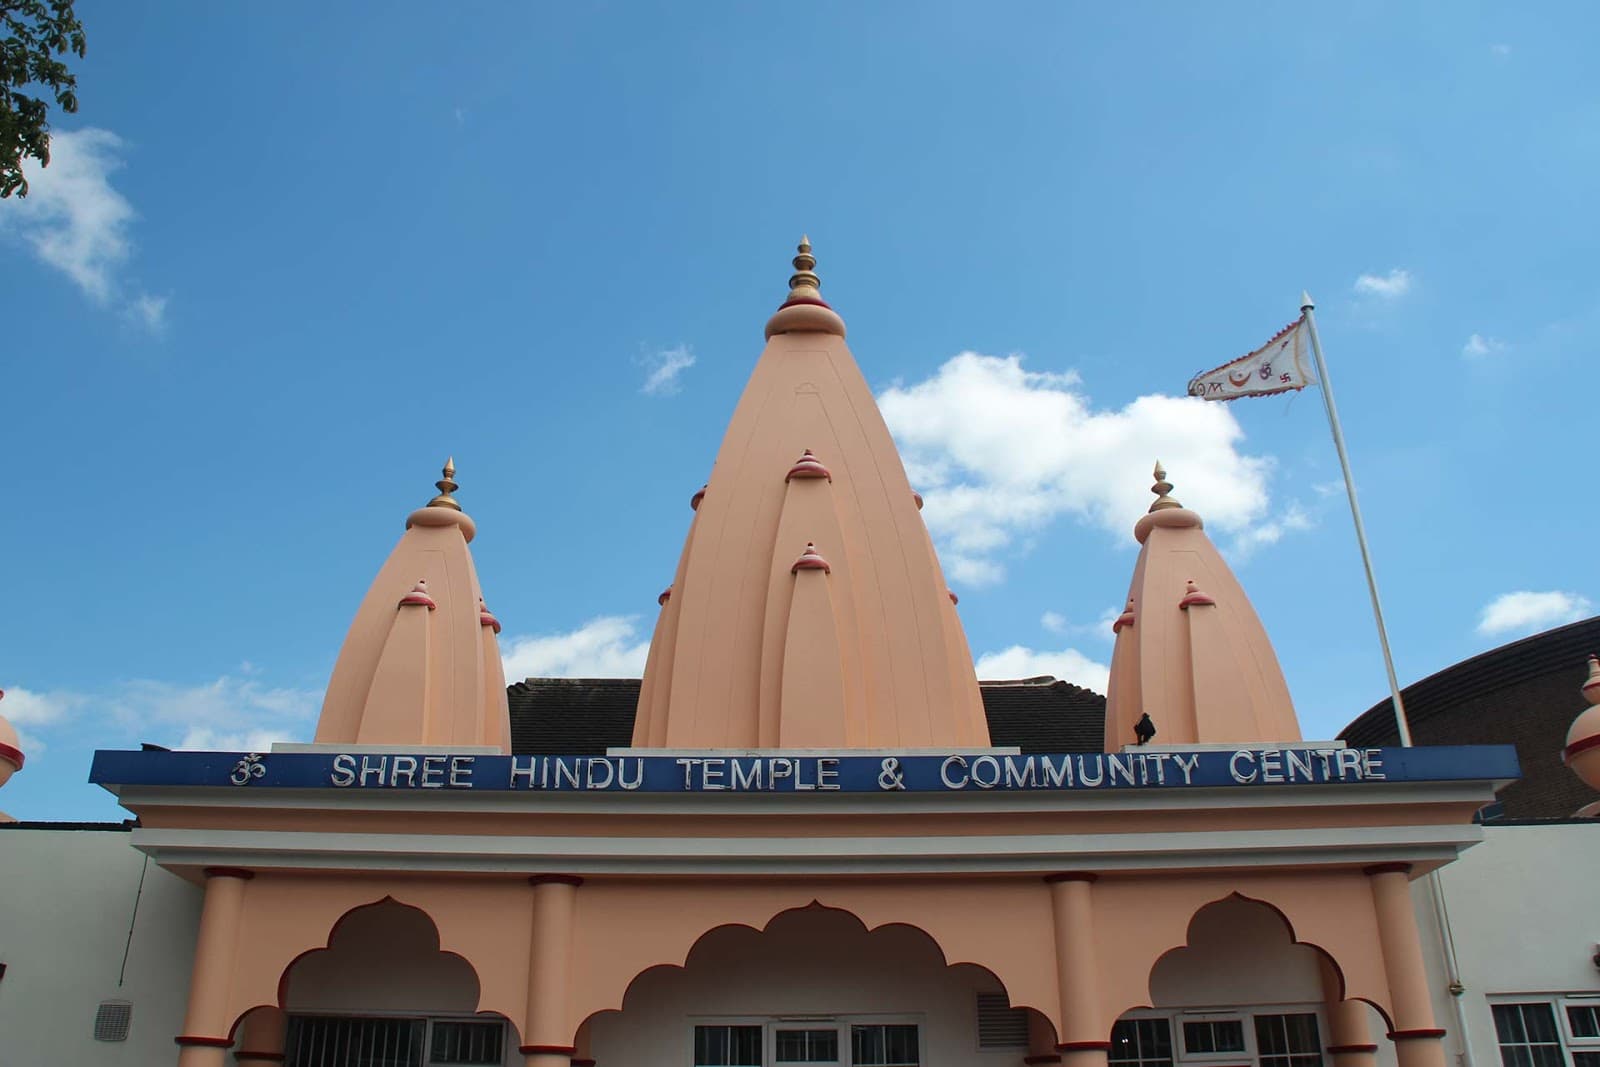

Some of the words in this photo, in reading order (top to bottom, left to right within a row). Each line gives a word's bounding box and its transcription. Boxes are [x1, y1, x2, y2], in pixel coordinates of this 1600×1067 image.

[331, 754, 475, 788] SHREE
[510, 756, 644, 790] HINDU
[676, 758, 841, 790] TEMPLE
[878, 757, 906, 792] &
[940, 753, 1200, 790] COMMUNITY
[1229, 748, 1386, 783] CENTRE
